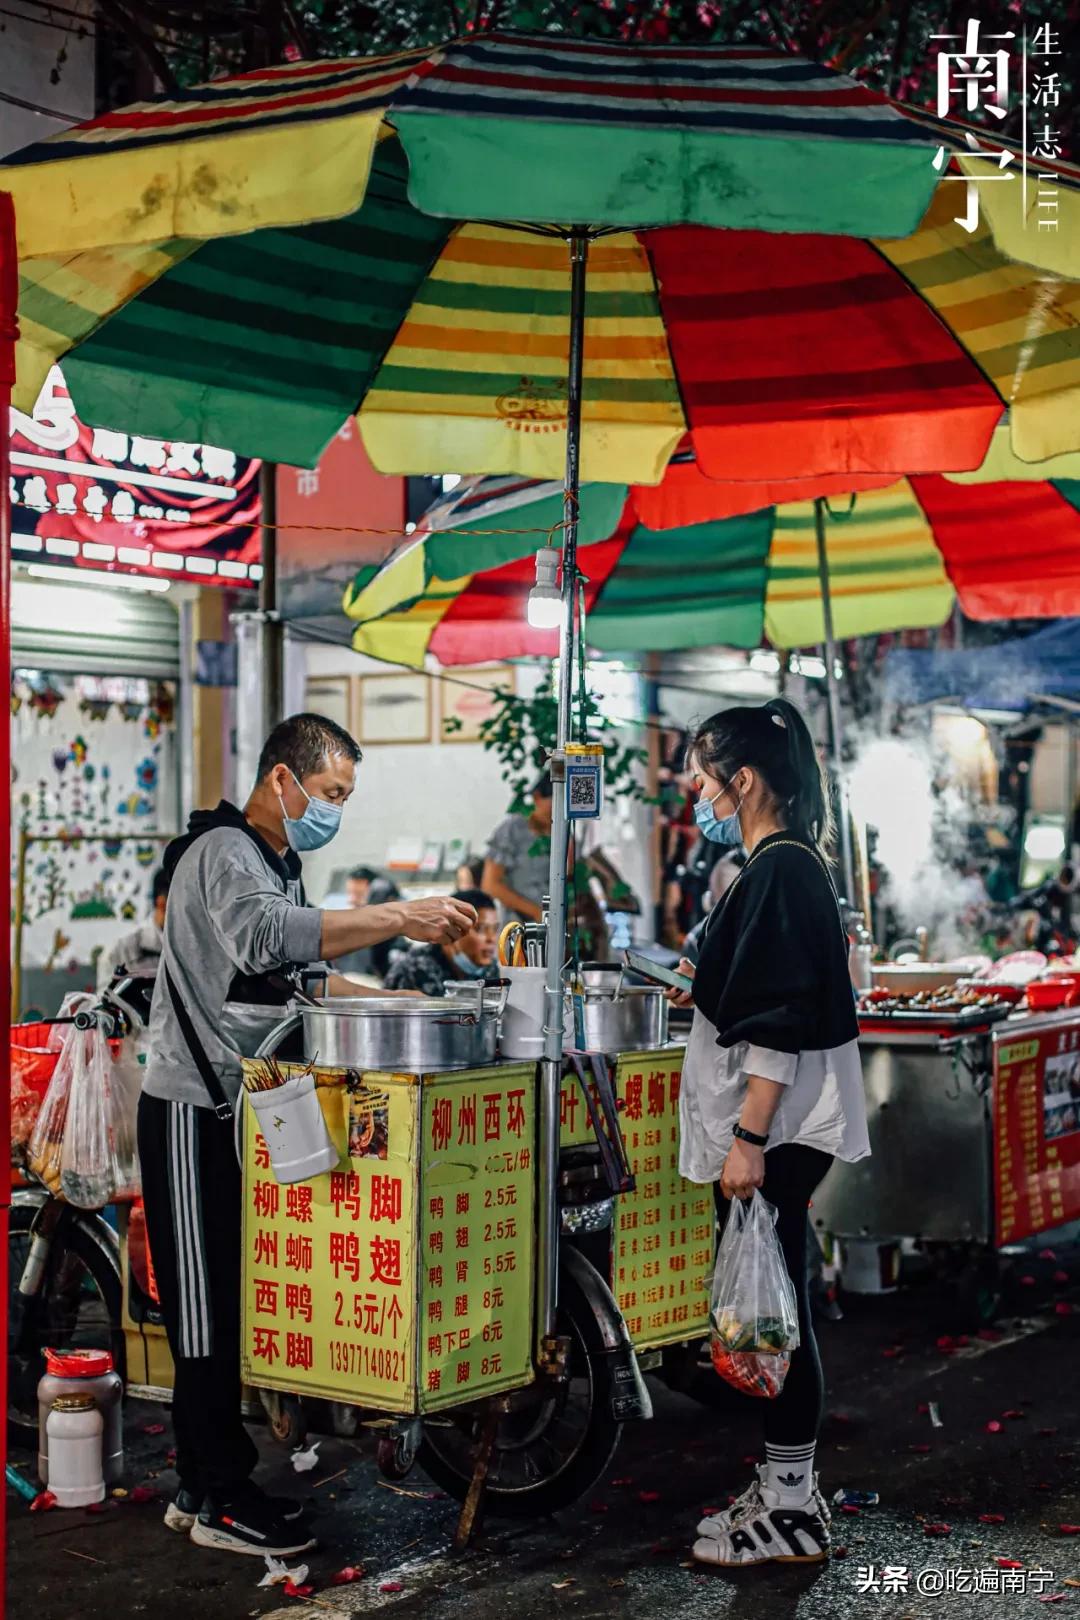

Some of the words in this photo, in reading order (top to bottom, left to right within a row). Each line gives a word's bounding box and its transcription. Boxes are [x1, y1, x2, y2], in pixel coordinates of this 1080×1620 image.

[432, 1088, 526, 1151] 柳州西环
[484, 1148, 531, 1173] 元/份
[330, 1170, 403, 1225] 鸭脚
[429, 1191, 470, 1220] 鸭脚
[484, 1184, 517, 1209] 2.5元
[484, 1217, 517, 1242] 2.5元
[330, 1231, 403, 1287] 鸭翅
[483, 1251, 516, 1275] 5.5元
[334, 1290, 404, 1340] 2.5元/个
[483, 1287, 504, 1309] 8元
[427, 1328, 471, 1357] 鸭下巴
[482, 1321, 503, 1343] 6元
[329, 1340, 406, 1383] 13977140821
[480, 1354, 502, 1375] 8元
